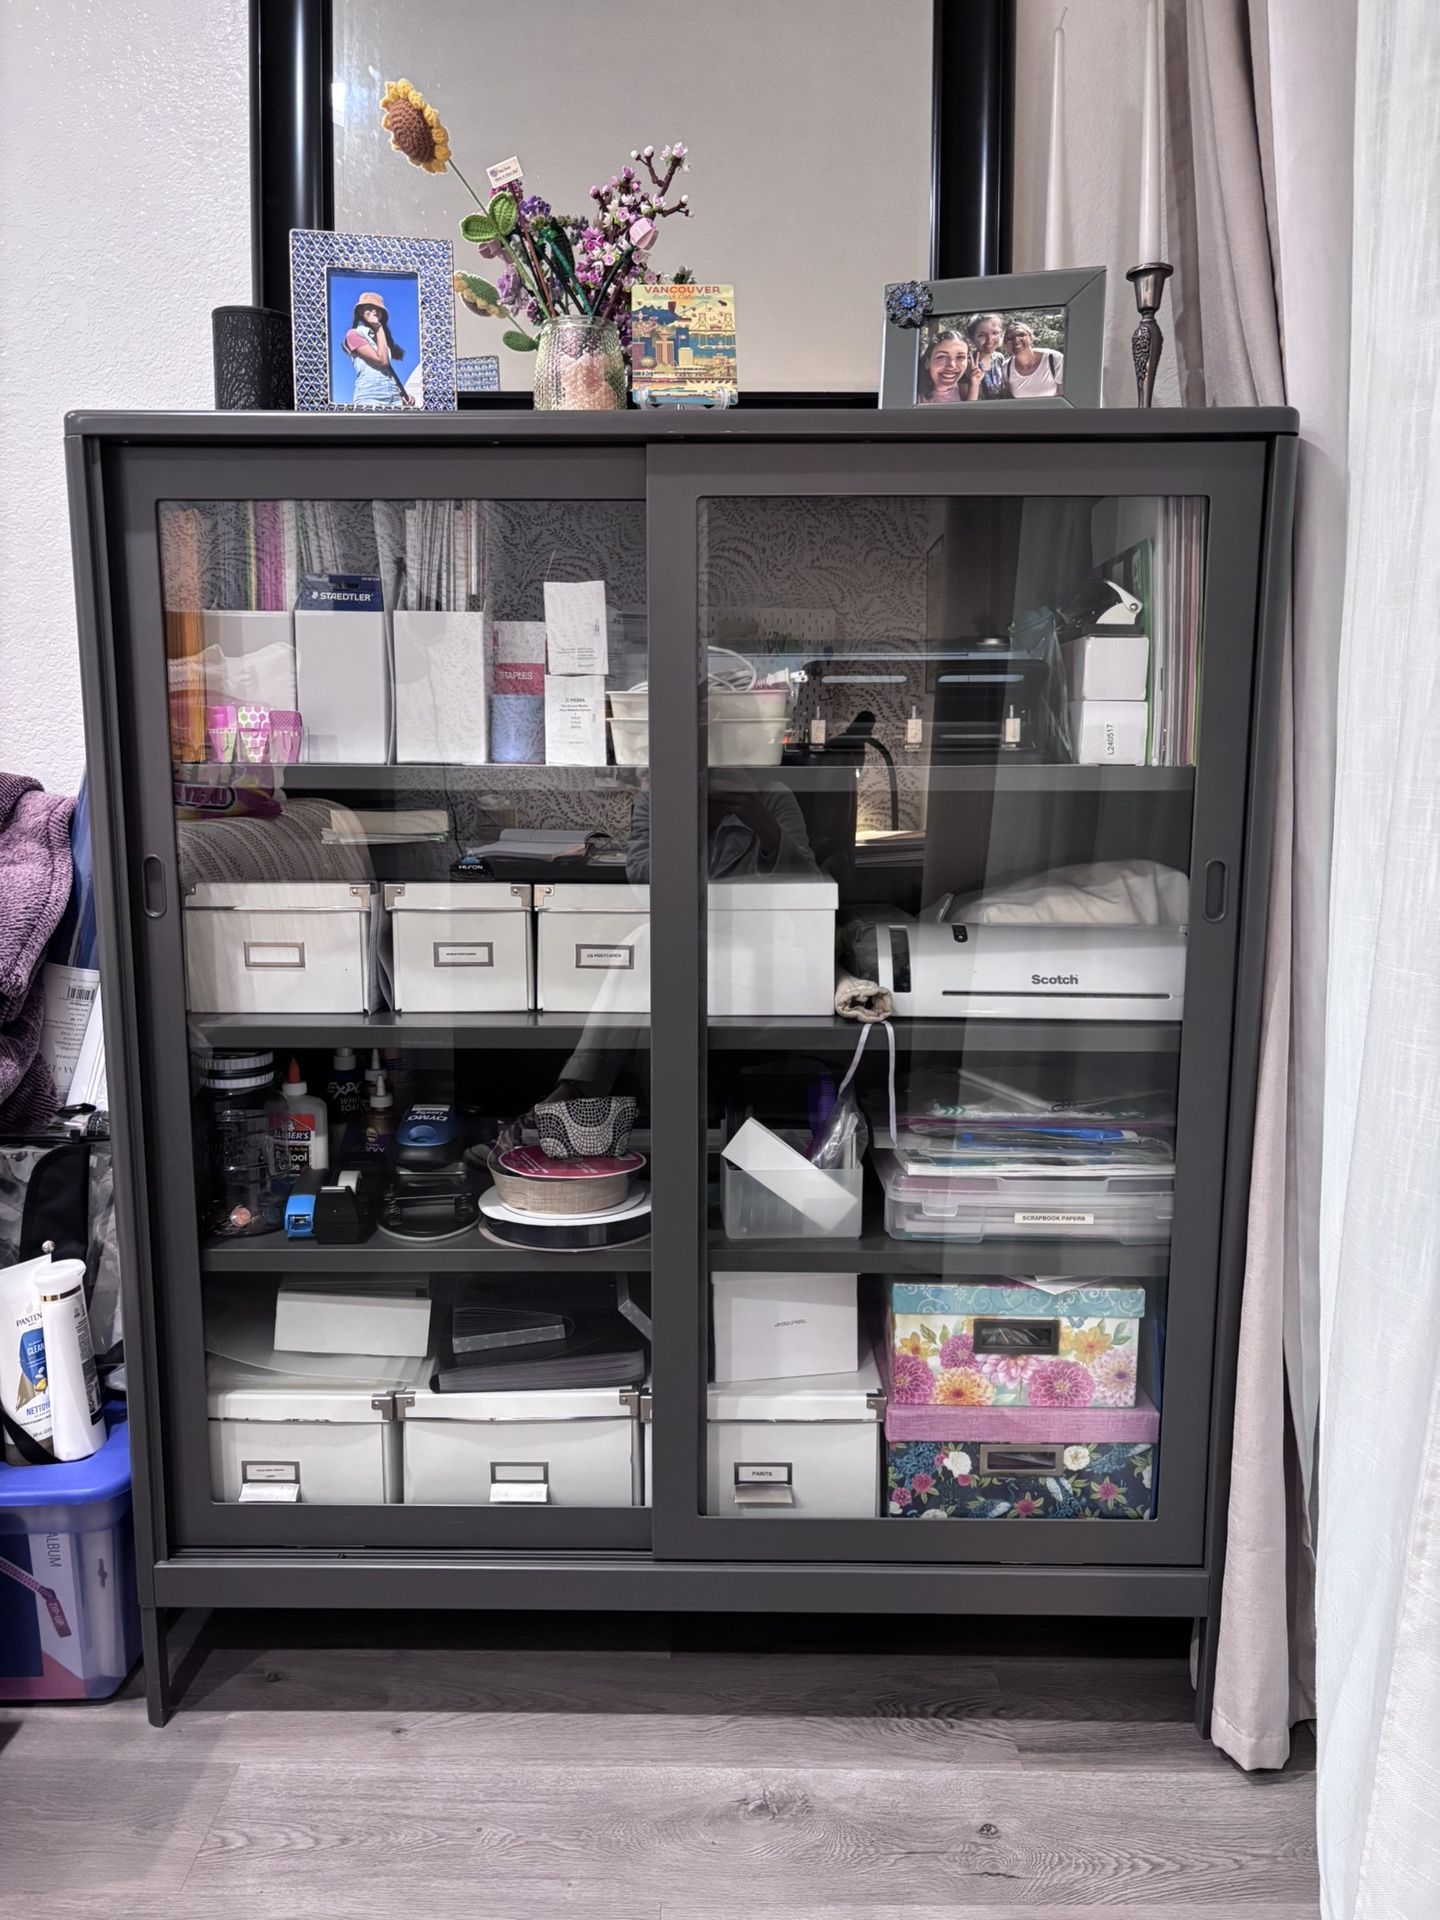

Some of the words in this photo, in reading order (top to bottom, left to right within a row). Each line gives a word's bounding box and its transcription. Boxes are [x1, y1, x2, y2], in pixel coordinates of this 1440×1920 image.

[643, 286, 721, 294] VANCOUVER
[319, 592, 372, 602] STAEDTLER
[499, 671, 534, 680] STAPLES
[1106, 723, 1115, 756] L240517
[1031, 974, 1079, 985] Scotch
[340, 1096, 361, 1105] WHI
[16, 1312, 43, 1328] PANTEN
[46, 1531, 63, 1568] ALBUM
[49, 1602, 65, 1626] ZIP-UP
